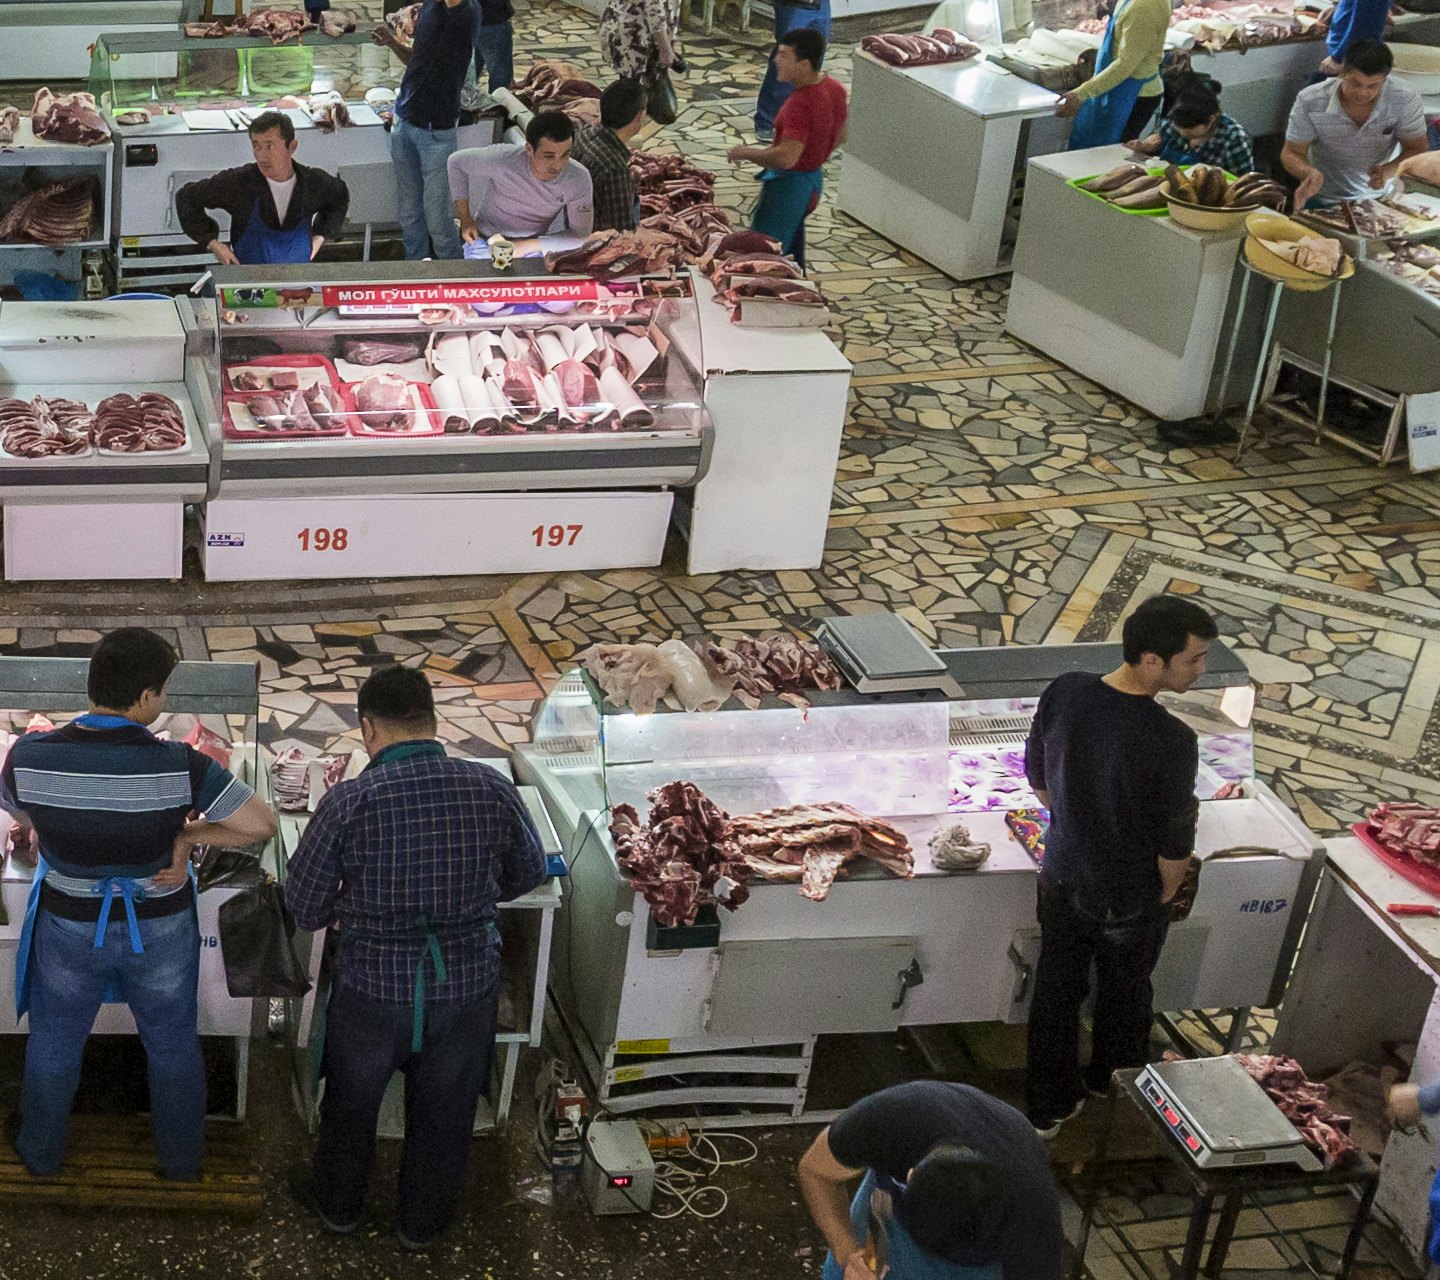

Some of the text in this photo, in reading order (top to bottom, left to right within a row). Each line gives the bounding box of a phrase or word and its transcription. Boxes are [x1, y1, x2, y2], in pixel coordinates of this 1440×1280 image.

[337, 284, 582, 302] МОЛ ГЎШТИ МАХСУЛОТЛАРИ
[209, 533, 232, 541] AZN
[296, 527, 349, 552] 198
[531, 523, 584, 548] 197
